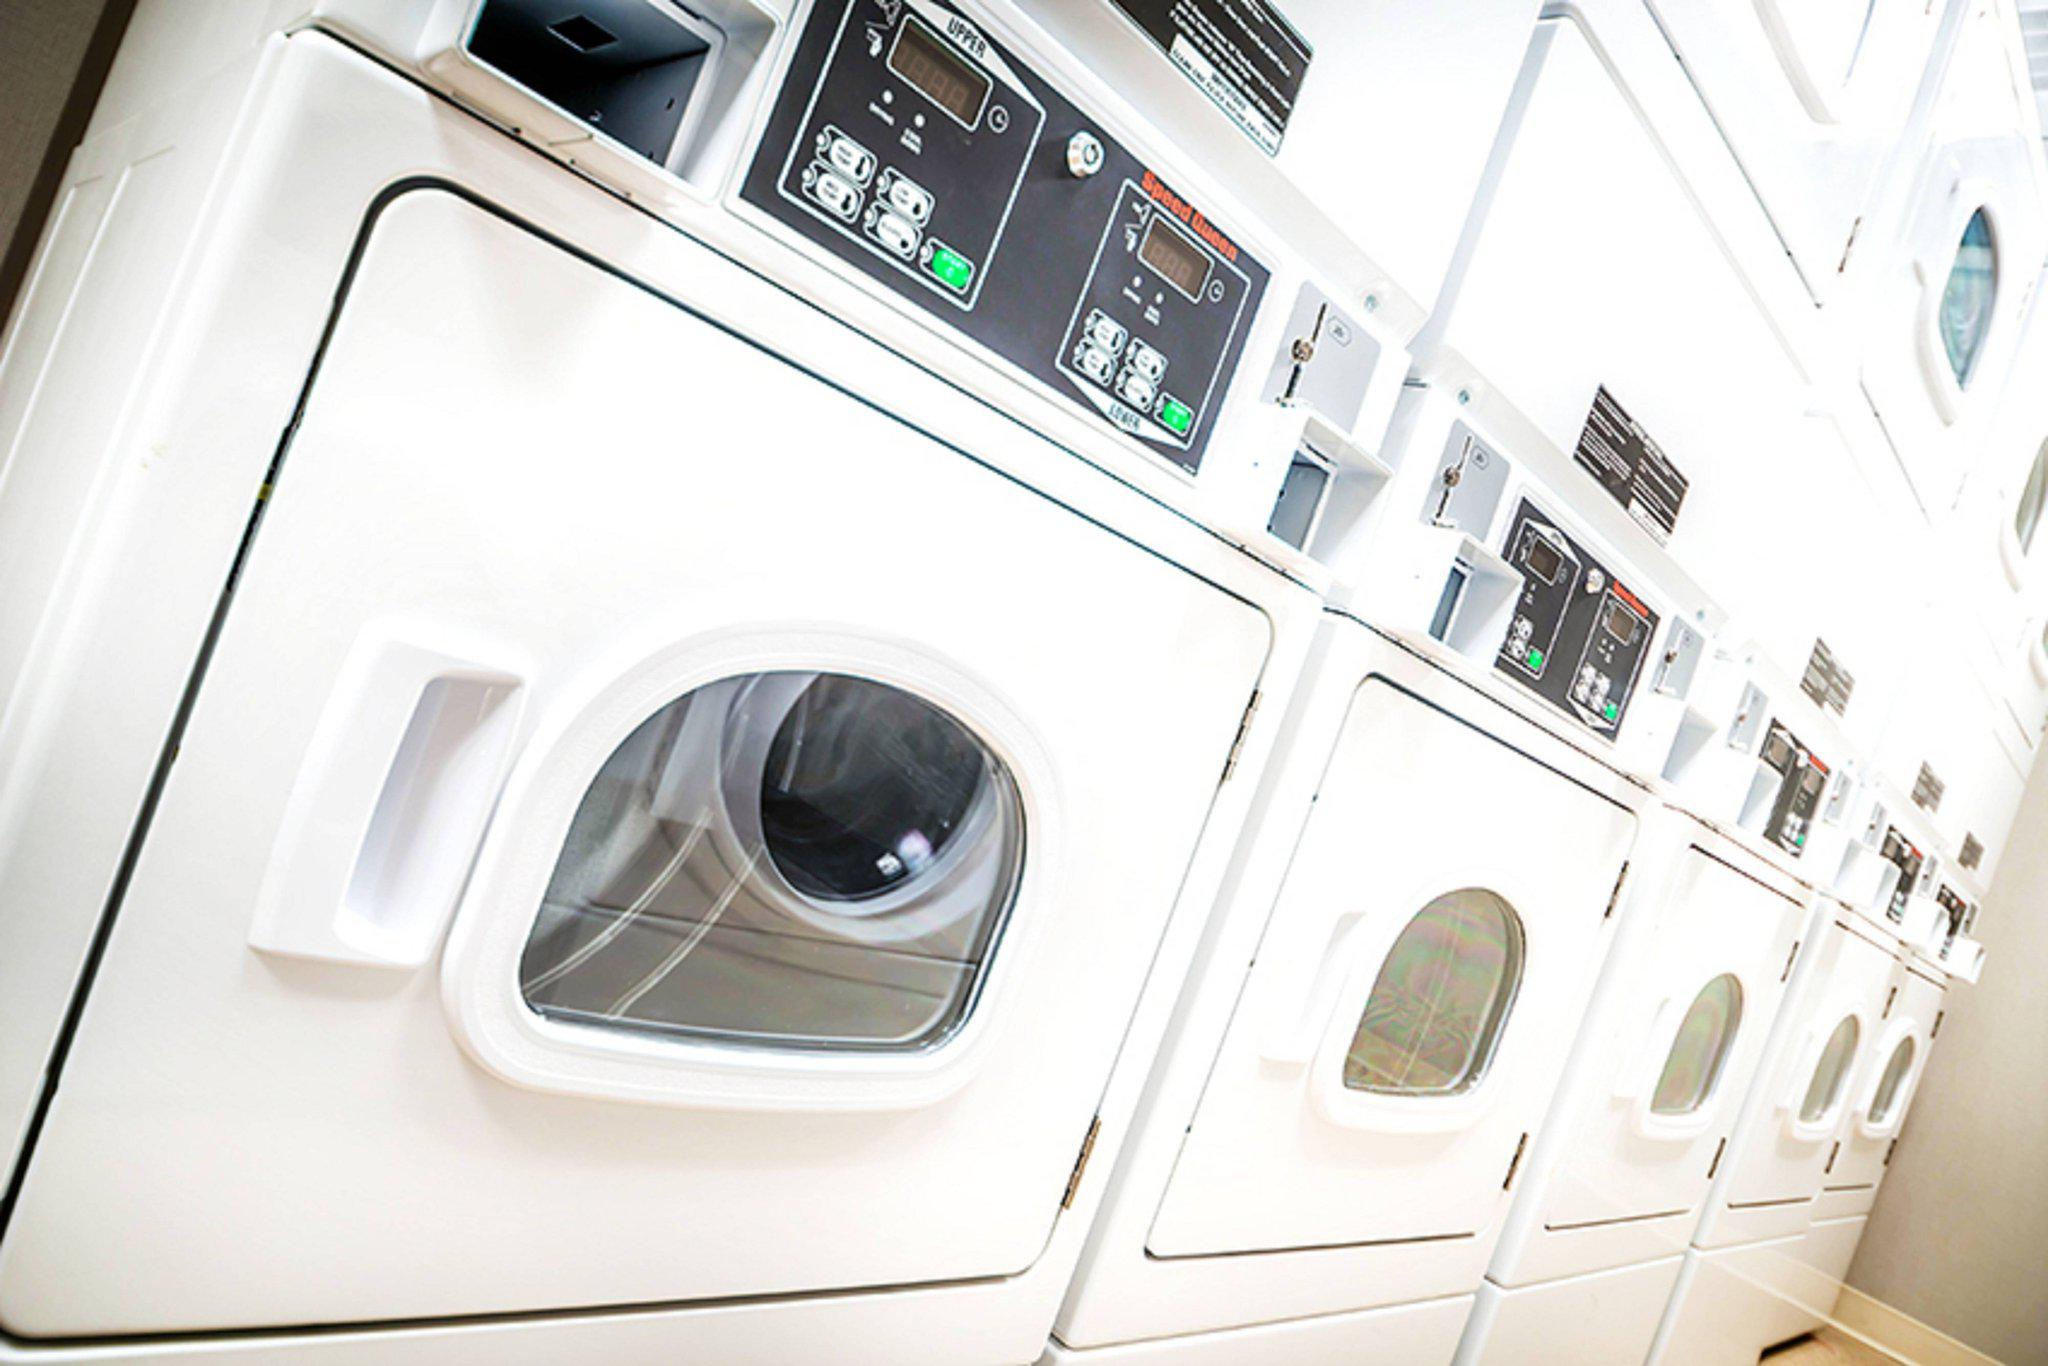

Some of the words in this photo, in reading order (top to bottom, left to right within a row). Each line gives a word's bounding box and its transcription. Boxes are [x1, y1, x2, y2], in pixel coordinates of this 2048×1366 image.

[947, 17, 987, 58] UPPER
[1141, 170, 1193, 222] Speed
[1191, 211, 1238, 262] Queen
[1108, 403, 1140, 432] LOWER
